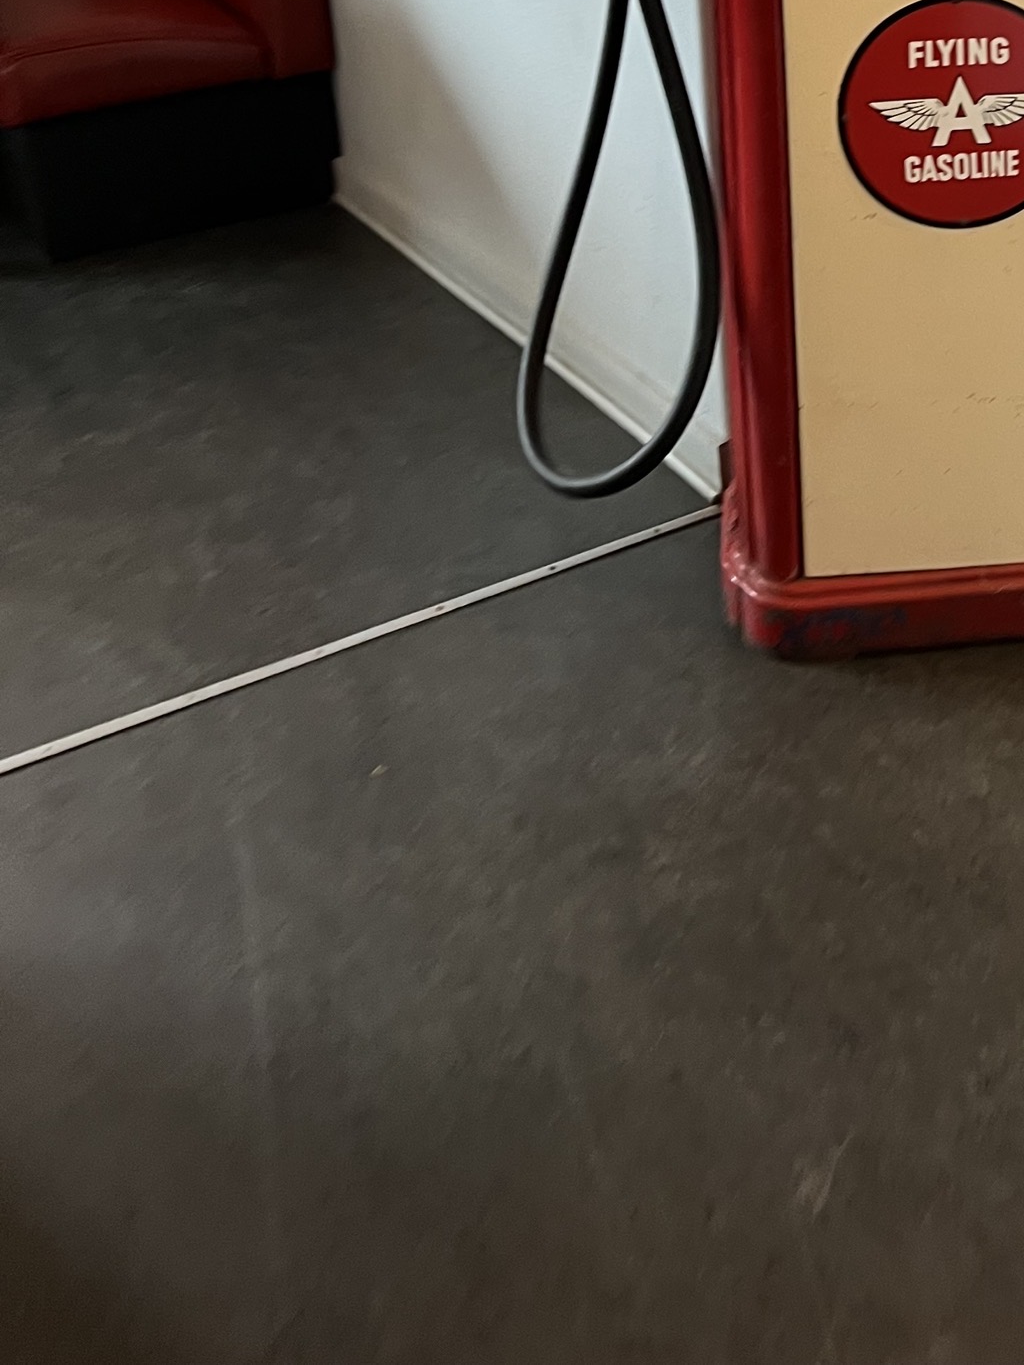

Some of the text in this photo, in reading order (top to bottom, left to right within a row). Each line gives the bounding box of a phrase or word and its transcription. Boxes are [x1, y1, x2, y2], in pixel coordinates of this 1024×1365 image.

[907, 37, 1010, 69] FLYING
[931, 75, 992, 147] A
[903, 149, 1020, 183] GASOLINE
